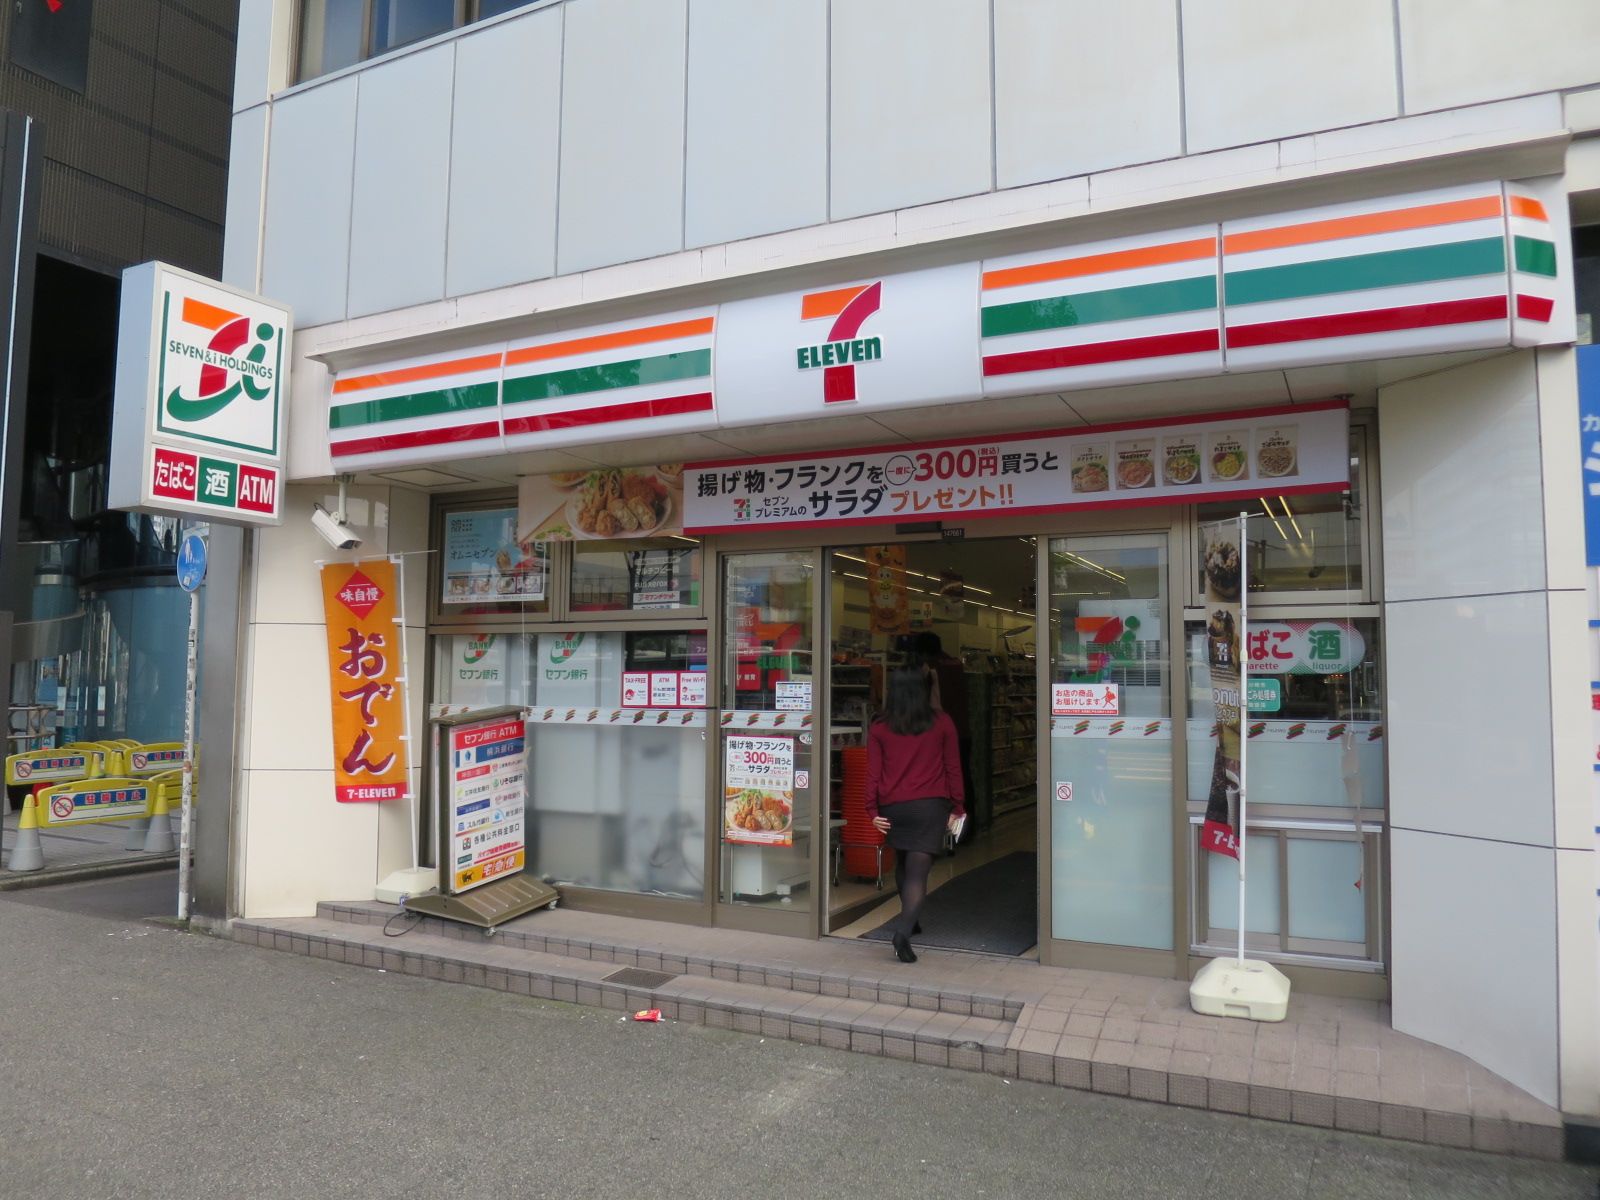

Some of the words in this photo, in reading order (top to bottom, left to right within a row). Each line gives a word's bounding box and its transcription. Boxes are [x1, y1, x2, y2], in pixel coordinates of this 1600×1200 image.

[797, 337, 882, 369] ELEVEN
[220, 356, 273, 380] HOLDINGS
[1001, 451, 1058, 476] 買うと
[155, 459, 195, 490] たばこ
[205, 467, 230, 497] 酒
[240, 475, 273, 505] ATM
[755, 506, 807, 518] プレミアムの
[809, 485, 888, 518] サラダ
[763, 496, 790, 507] セブン
[341, 587, 379, 602] 味自慢
[1247, 629, 1294, 660] ばこ
[1308, 629, 1341, 660] 酒
[459, 669, 499, 680] セブン銀行
[545, 669, 589, 680] セブン銀行
[1312, 662, 1342, 672] liquor
[339, 628, 397, 776] おでん
[464, 730, 497, 744] セブン銀行
[499, 726, 517, 737] ATM
[748, 765, 770, 774] サラダ
[347, 786, 396, 799] 7-ELEVEN
[482, 855, 516, 877] 宅急便
